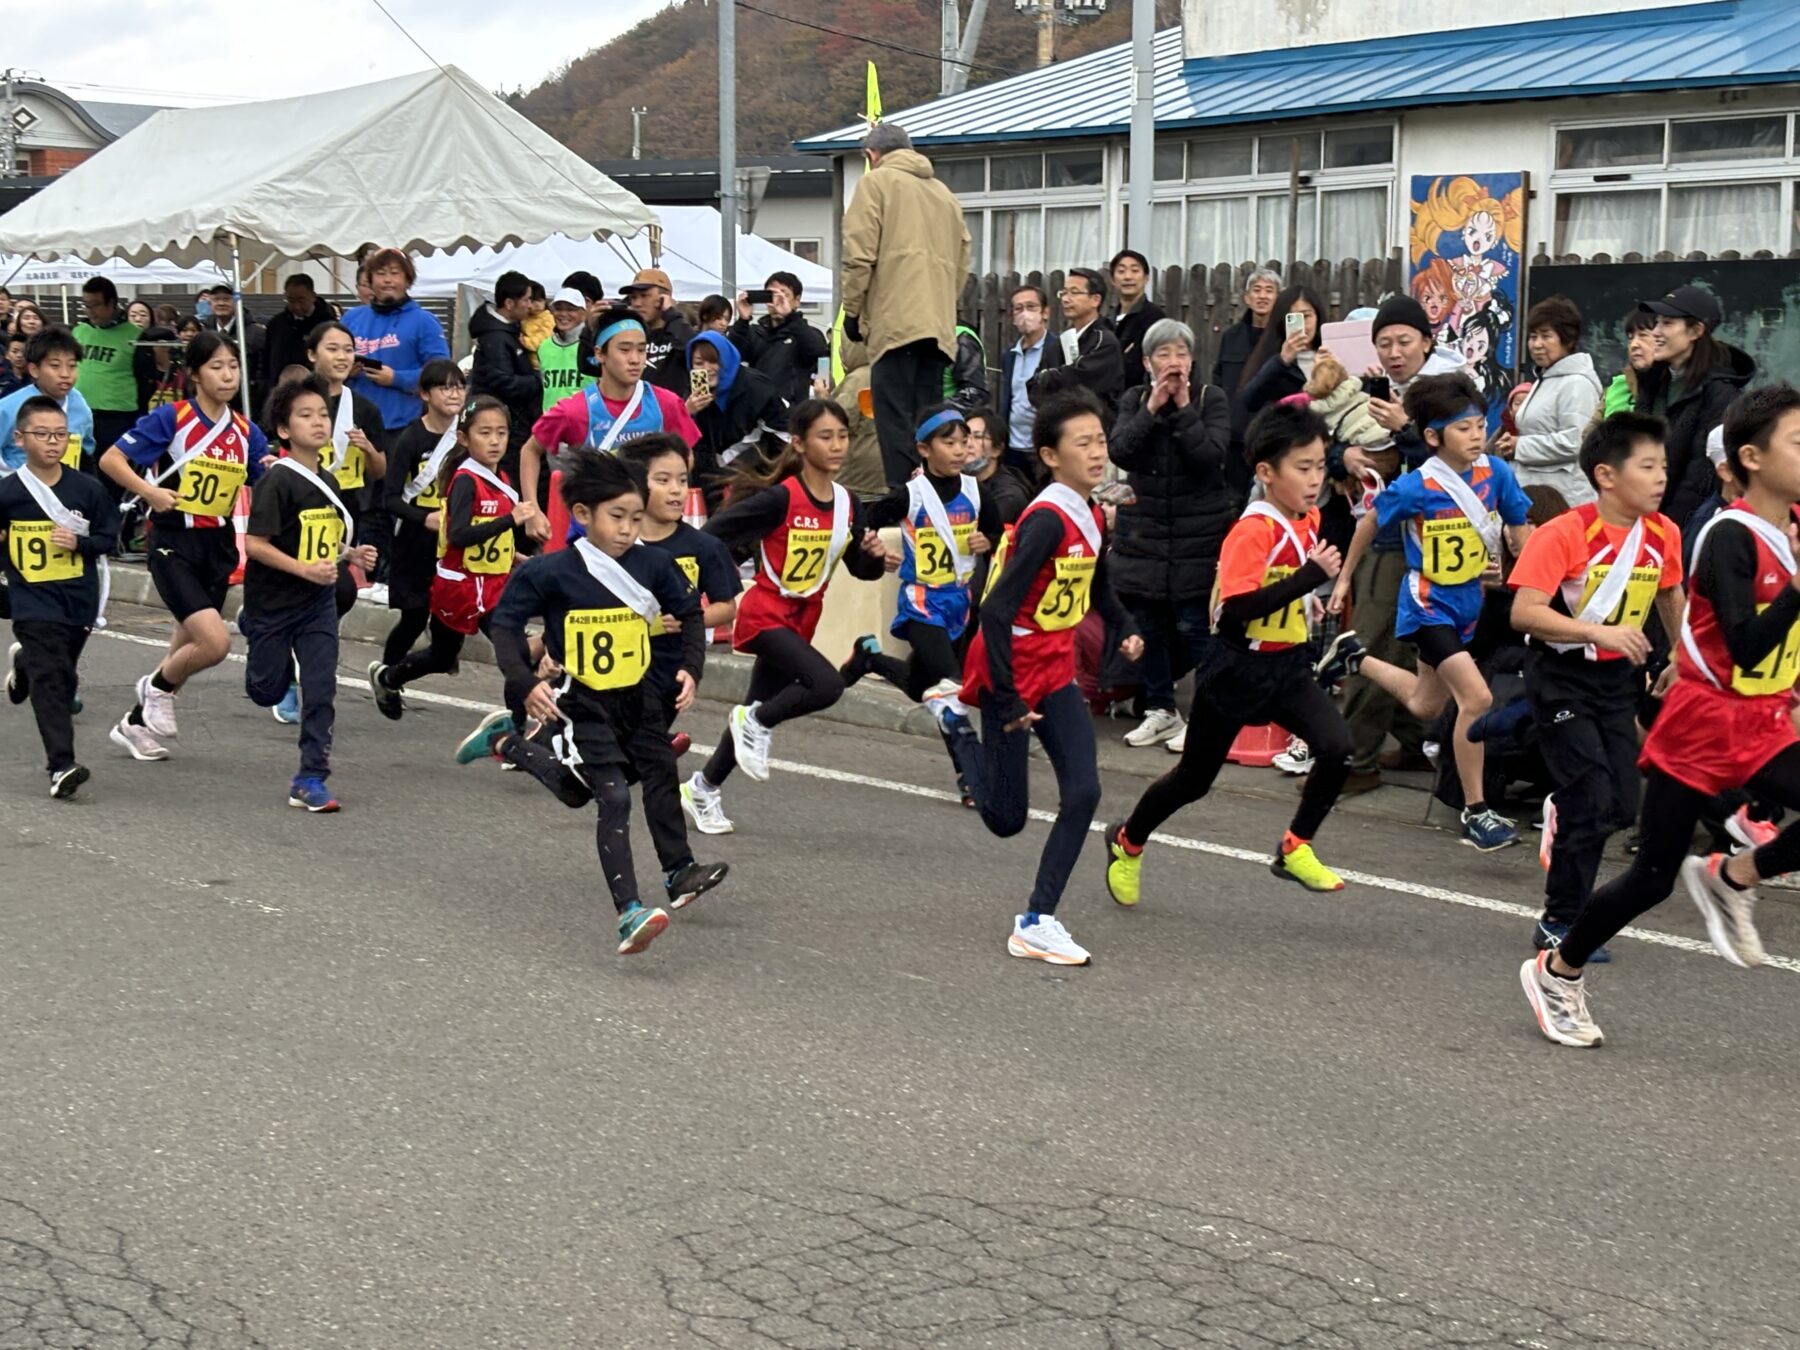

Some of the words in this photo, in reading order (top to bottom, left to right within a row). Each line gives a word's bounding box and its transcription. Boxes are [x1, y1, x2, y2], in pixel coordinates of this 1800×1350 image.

[83, 344, 117, 363] TAFF
[183, 470, 239, 508] 30-1
[793, 515, 819, 529] C.R.S
[786, 547, 825, 582] 22
[919, 542, 955, 576] 34
[576, 630, 645, 676] 18-1
